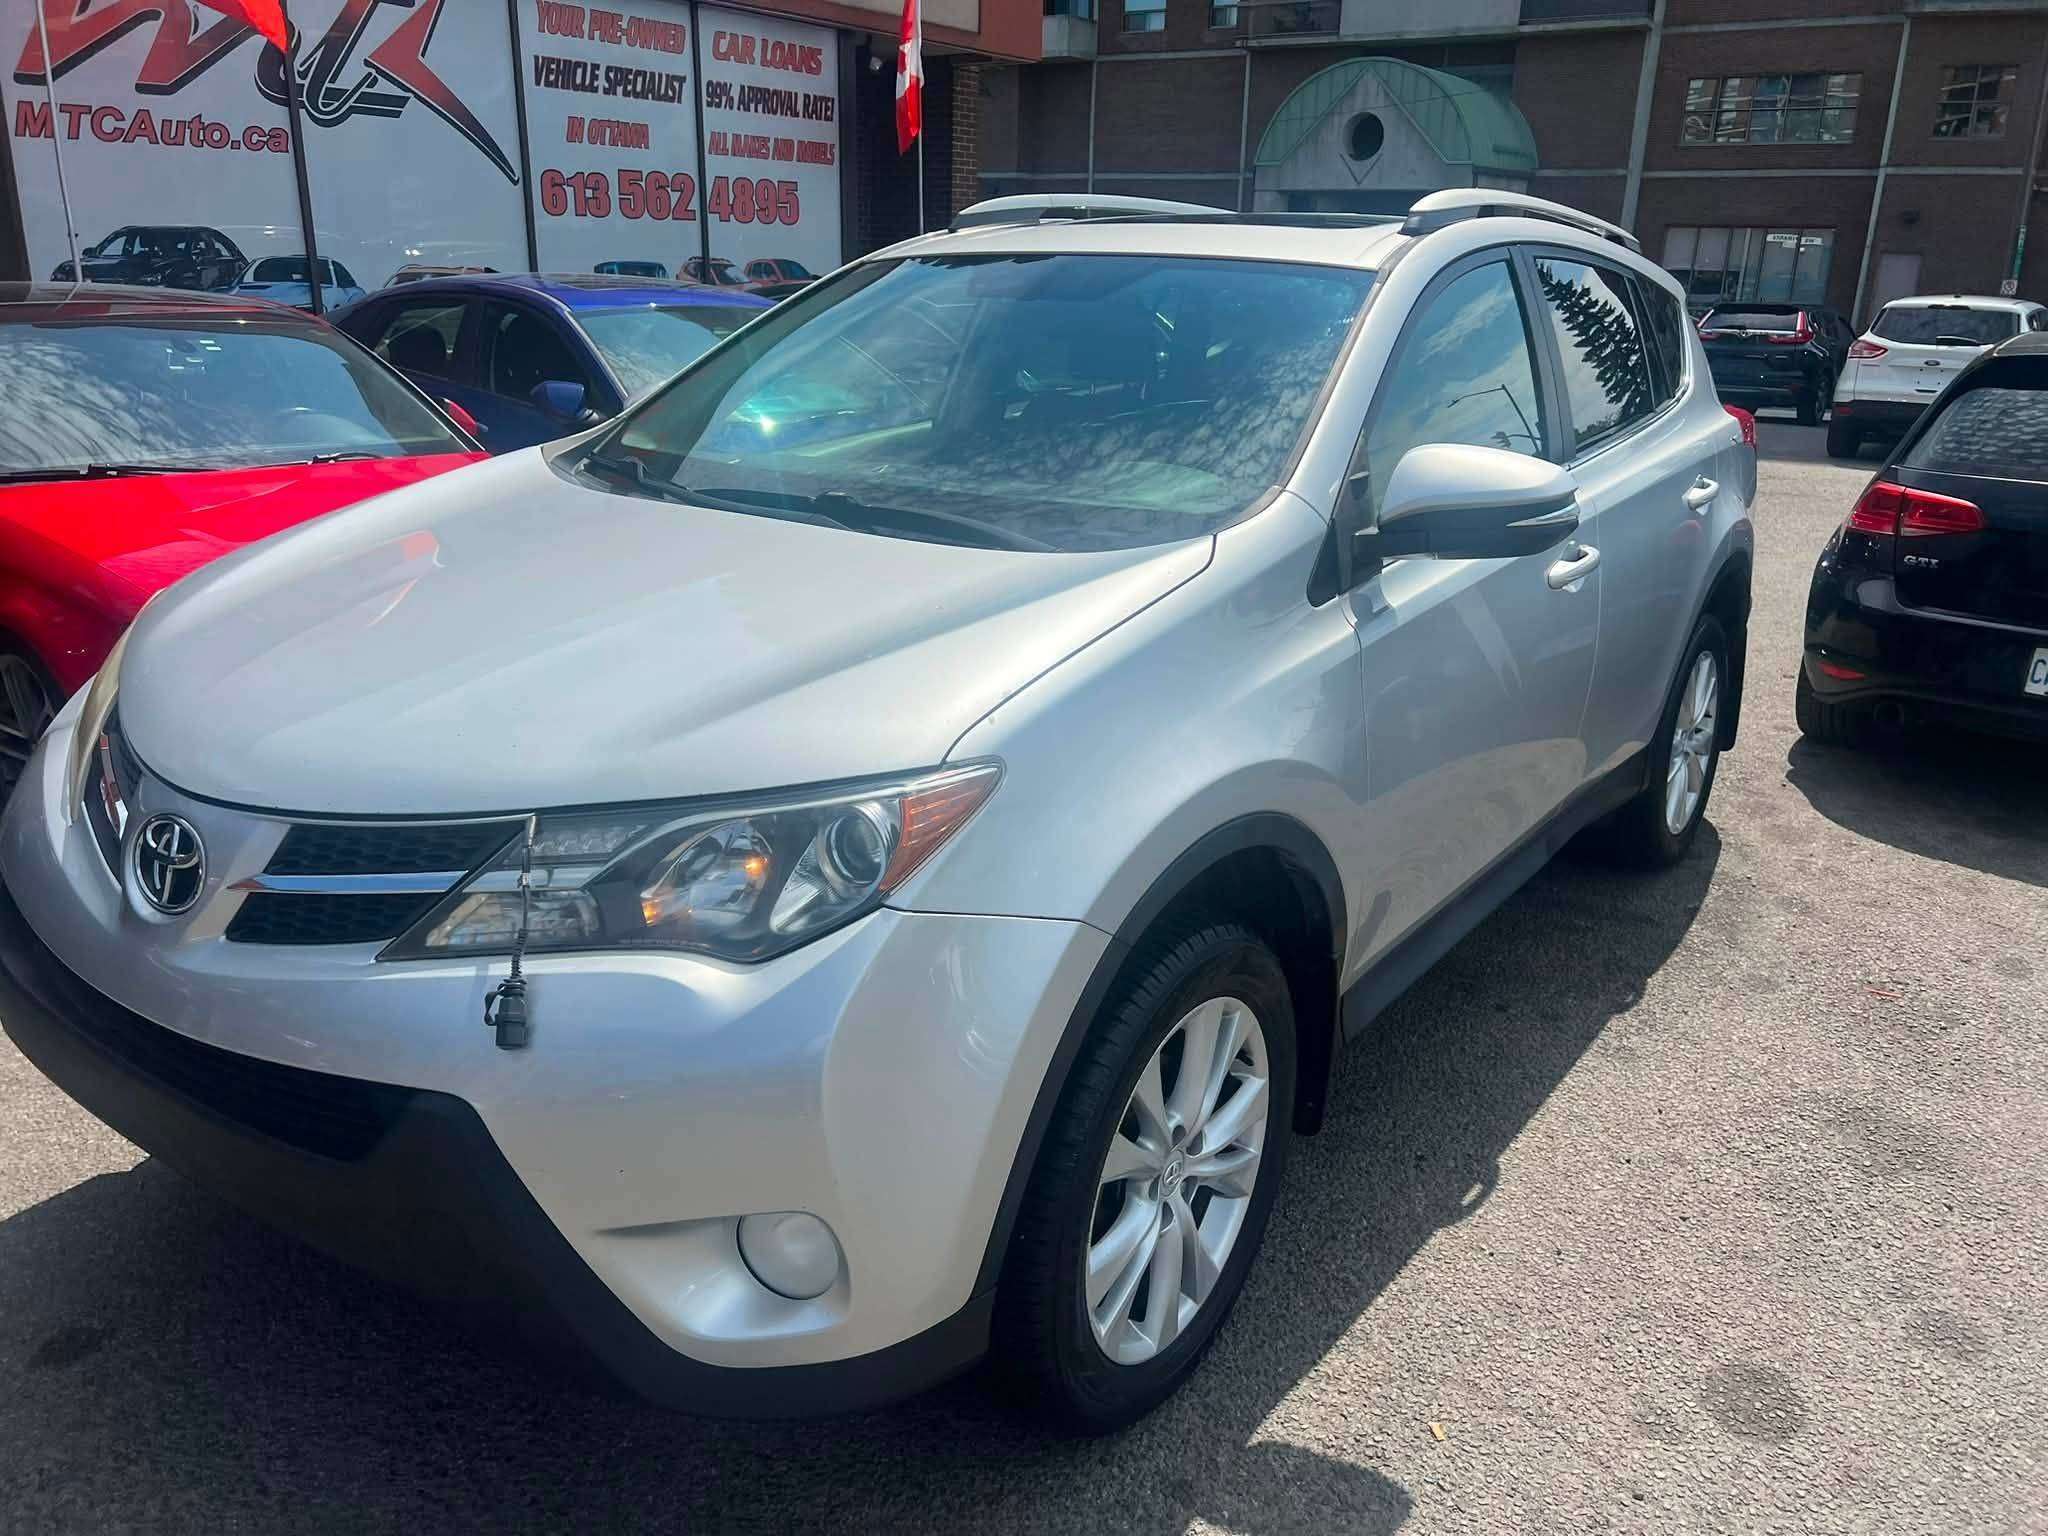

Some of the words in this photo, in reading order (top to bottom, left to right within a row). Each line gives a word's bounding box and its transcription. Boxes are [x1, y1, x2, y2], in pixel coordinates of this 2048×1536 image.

[535, 0, 586, 39] YOUR
[588, 8, 686, 55] PRE-OWNED
[712, 30, 756, 65] CAR
[760, 38, 823, 76] LOANS
[533, 54, 601, 94] VEHICLE
[602, 64, 687, 104] SPECIALIST
[706, 79, 734, 110] 99%
[737, 84, 800, 118] APPROVAL
[15, 100, 290, 153] MTCAuto.ca
[566, 115, 585, 143] IN
[587, 118, 650, 150] OTTAWA
[708, 131, 730, 156] ALL
[540, 169, 612, 219] 613
[617, 169, 697, 221] 562
[708, 176, 801, 225] 4895
[1903, 555, 1939, 568] GTI
